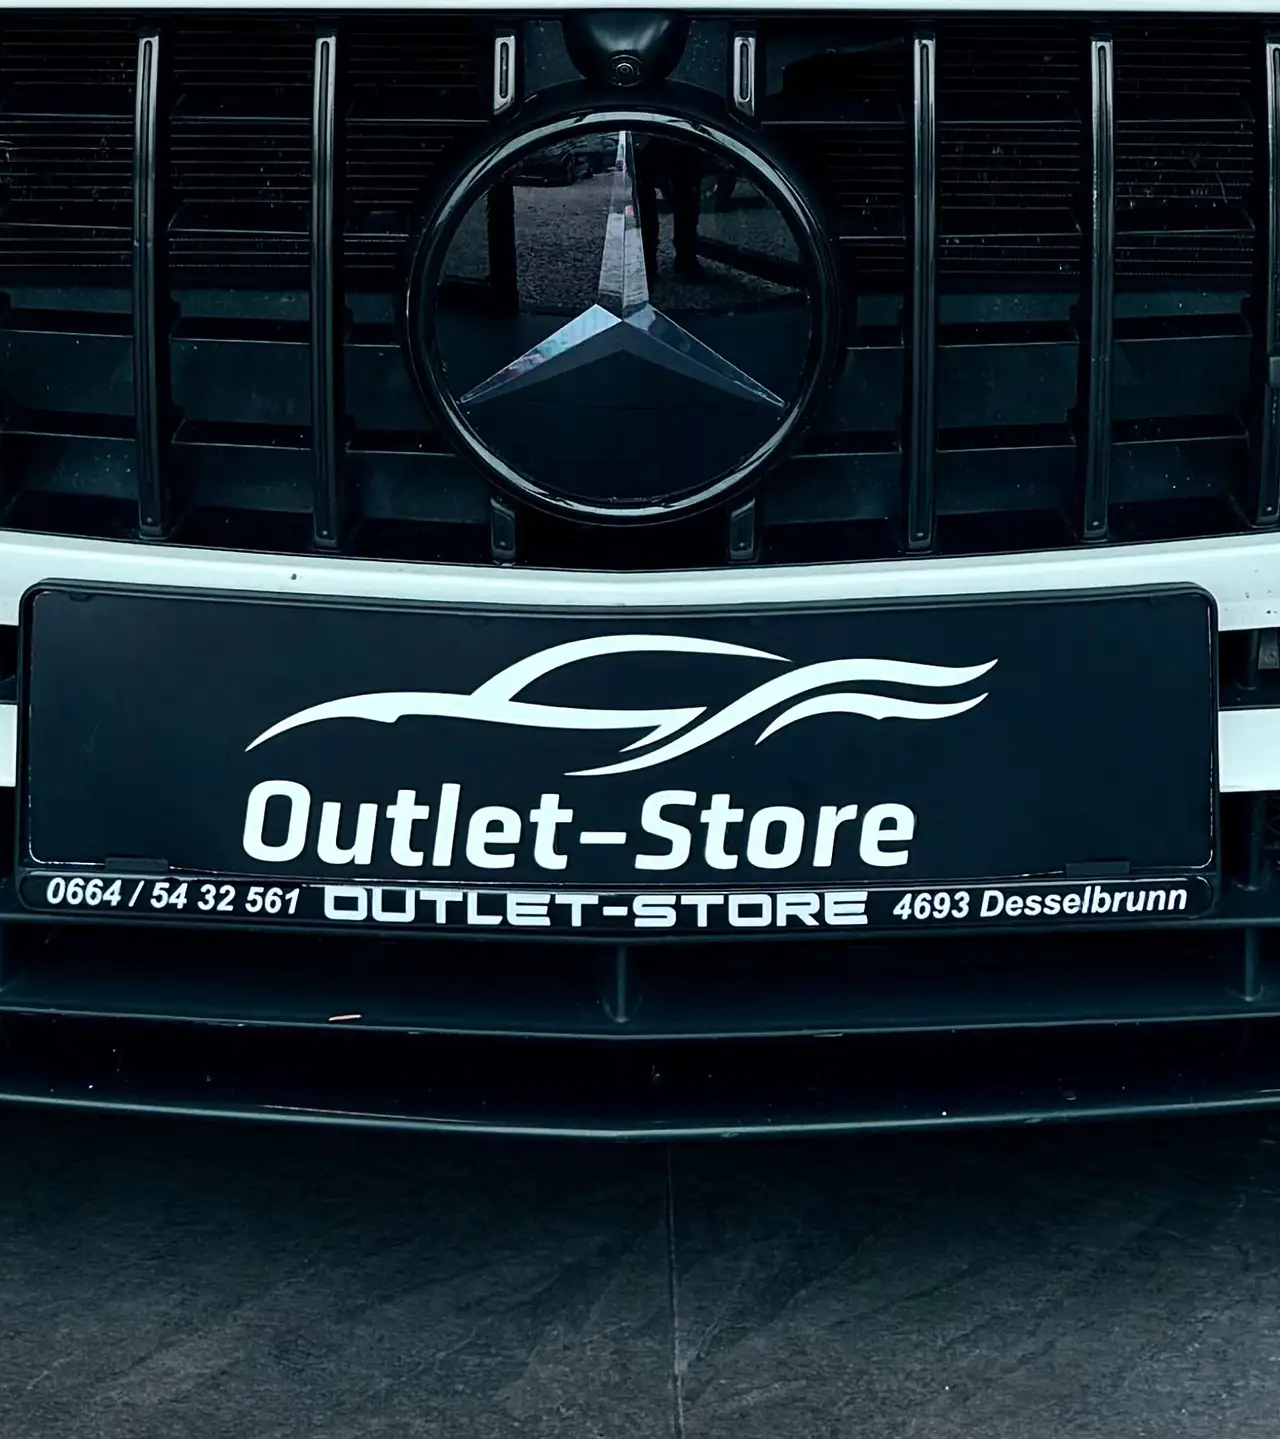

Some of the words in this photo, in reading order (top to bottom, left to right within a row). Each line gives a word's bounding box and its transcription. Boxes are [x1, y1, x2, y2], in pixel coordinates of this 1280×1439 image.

[242, 779, 915, 871] Outlet-Store
[46, 876, 122, 907] 0664
[149, 881, 188, 910] 54
[197, 883, 236, 912] 32
[244, 886, 301, 915] 561
[323, 884, 869, 928] OUTLET-STORE
[892, 890, 970, 920] 4693
[979, 885, 1188, 918] Desselbrunn
